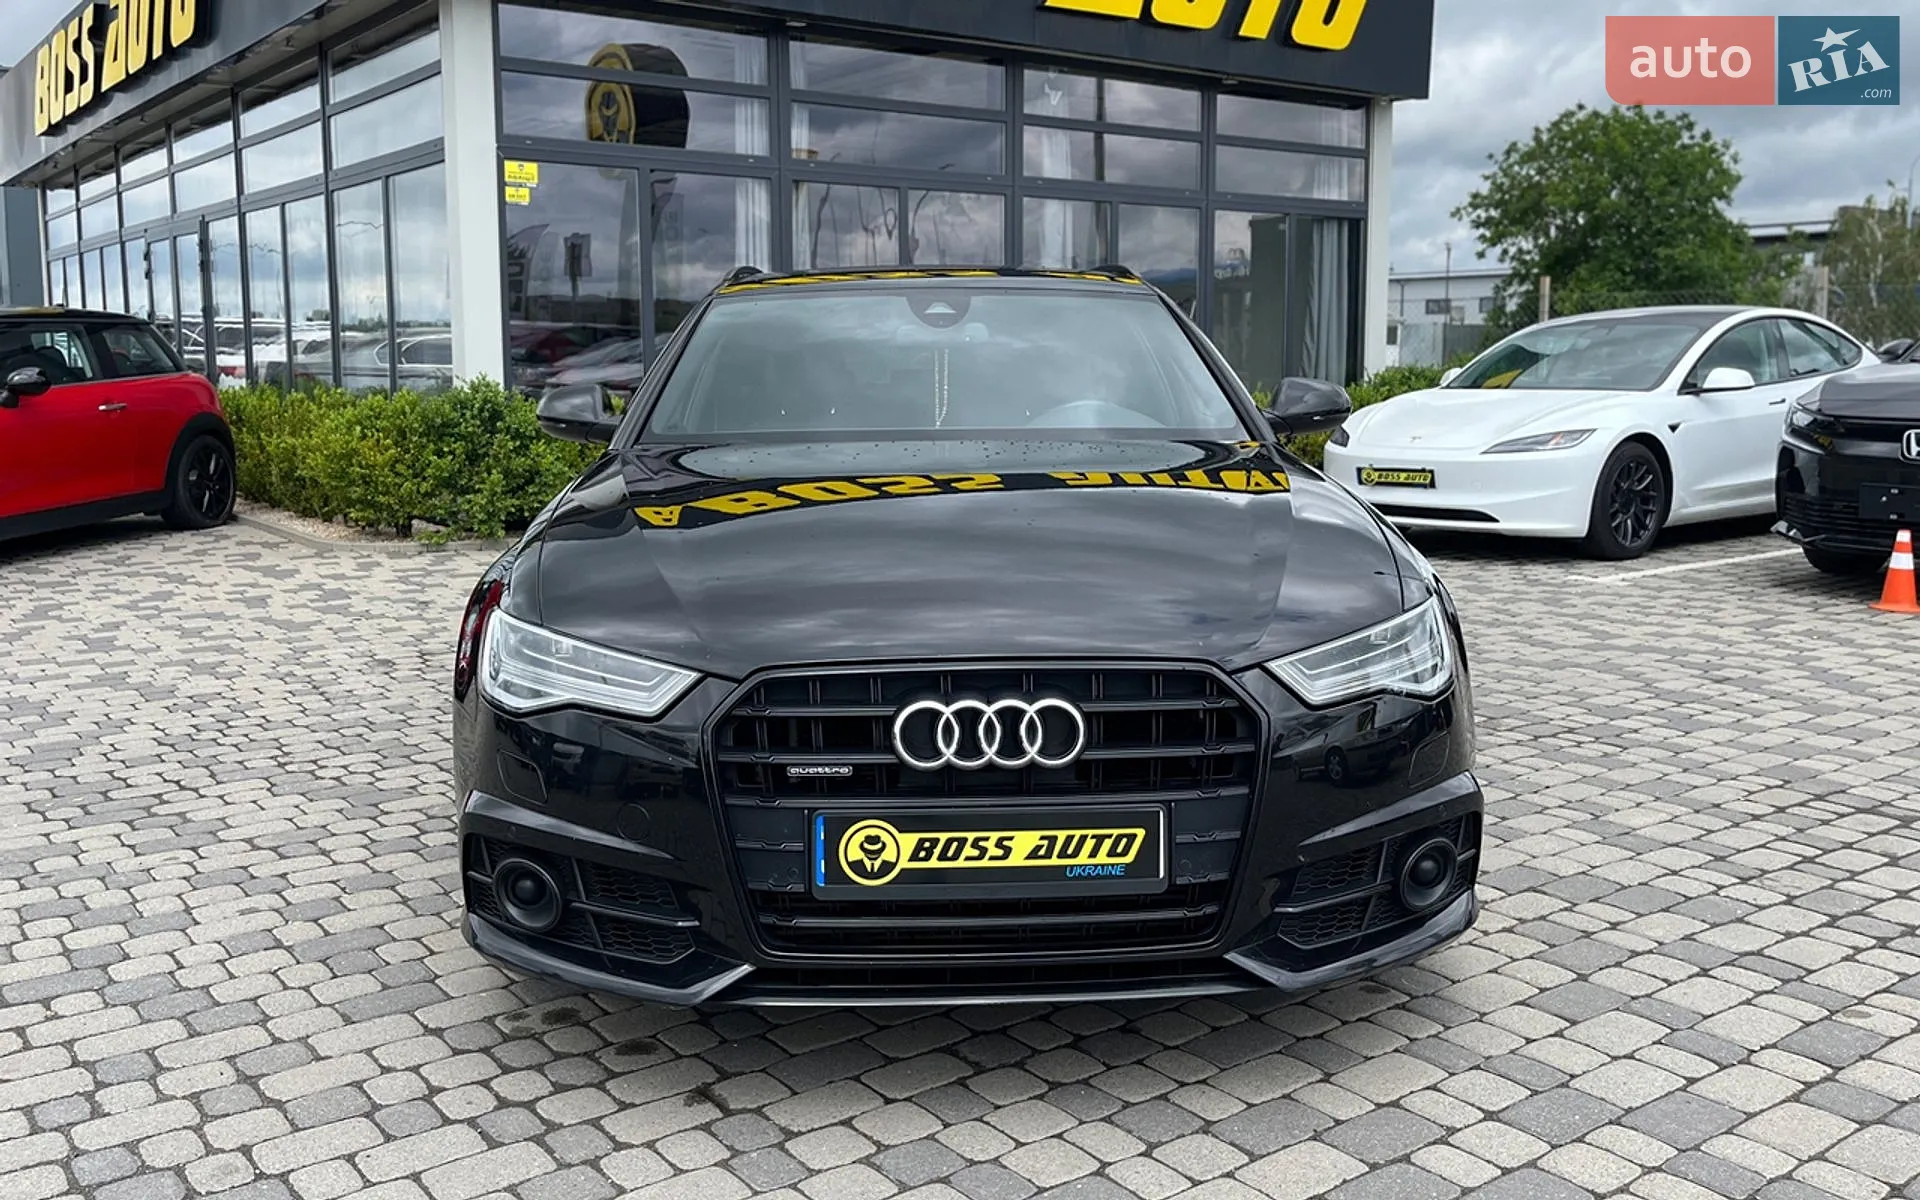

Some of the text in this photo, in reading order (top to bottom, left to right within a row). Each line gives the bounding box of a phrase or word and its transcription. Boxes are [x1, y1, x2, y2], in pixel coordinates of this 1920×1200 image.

[35, 3, 94, 136] BOSS
[790, 767, 849, 776] quattro
[907, 832, 1138, 863] BOSS AUTO
[1065, 864, 1127, 878] UKRAINE
